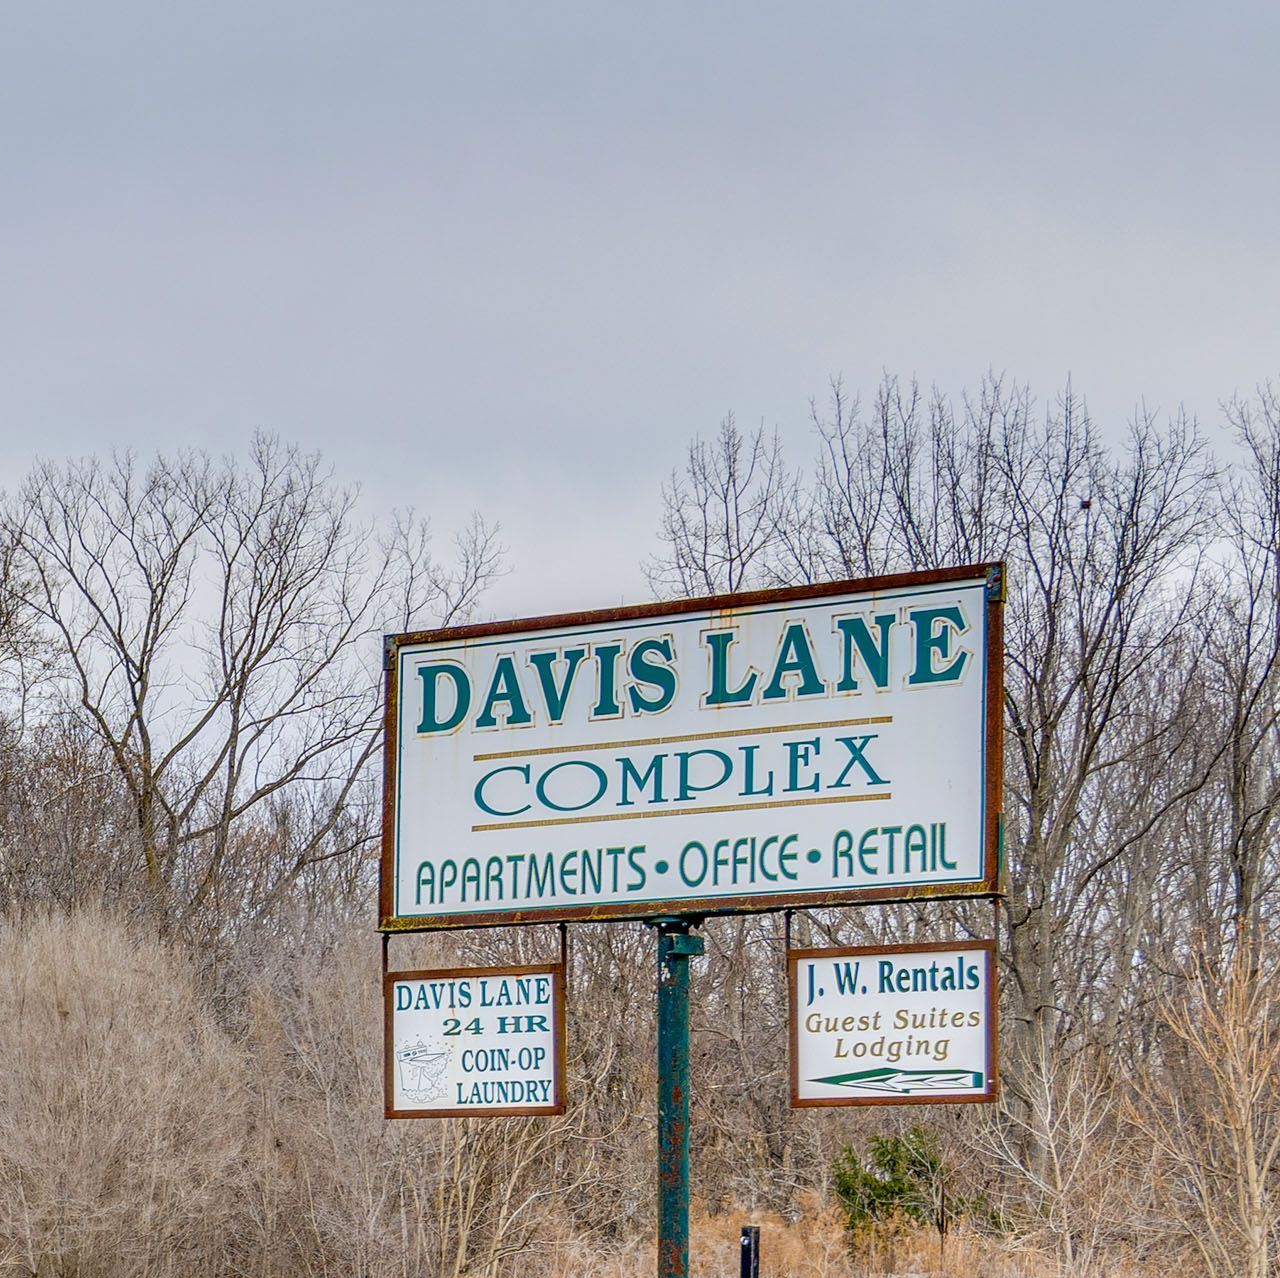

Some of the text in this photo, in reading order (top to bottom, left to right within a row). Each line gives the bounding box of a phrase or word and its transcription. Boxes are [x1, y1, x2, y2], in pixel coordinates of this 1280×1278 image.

[415, 603, 971, 735] DAVIS LANE
[473, 734, 891, 817] COMPLEX
[415, 822, 958, 905] APARTMENTS OFFICE RETAIL
[396, 977, 550, 1011] DAVIS LANE
[806, 956, 981, 1007] J. W. Rentals
[442, 1015, 550, 1036] 24 HR
[805, 1007, 981, 1034] Guest Suites
[461, 1047, 546, 1073] COIN-OP
[833, 1034, 951, 1063] Lodging
[456, 1079, 552, 1105] LAUNDRY
